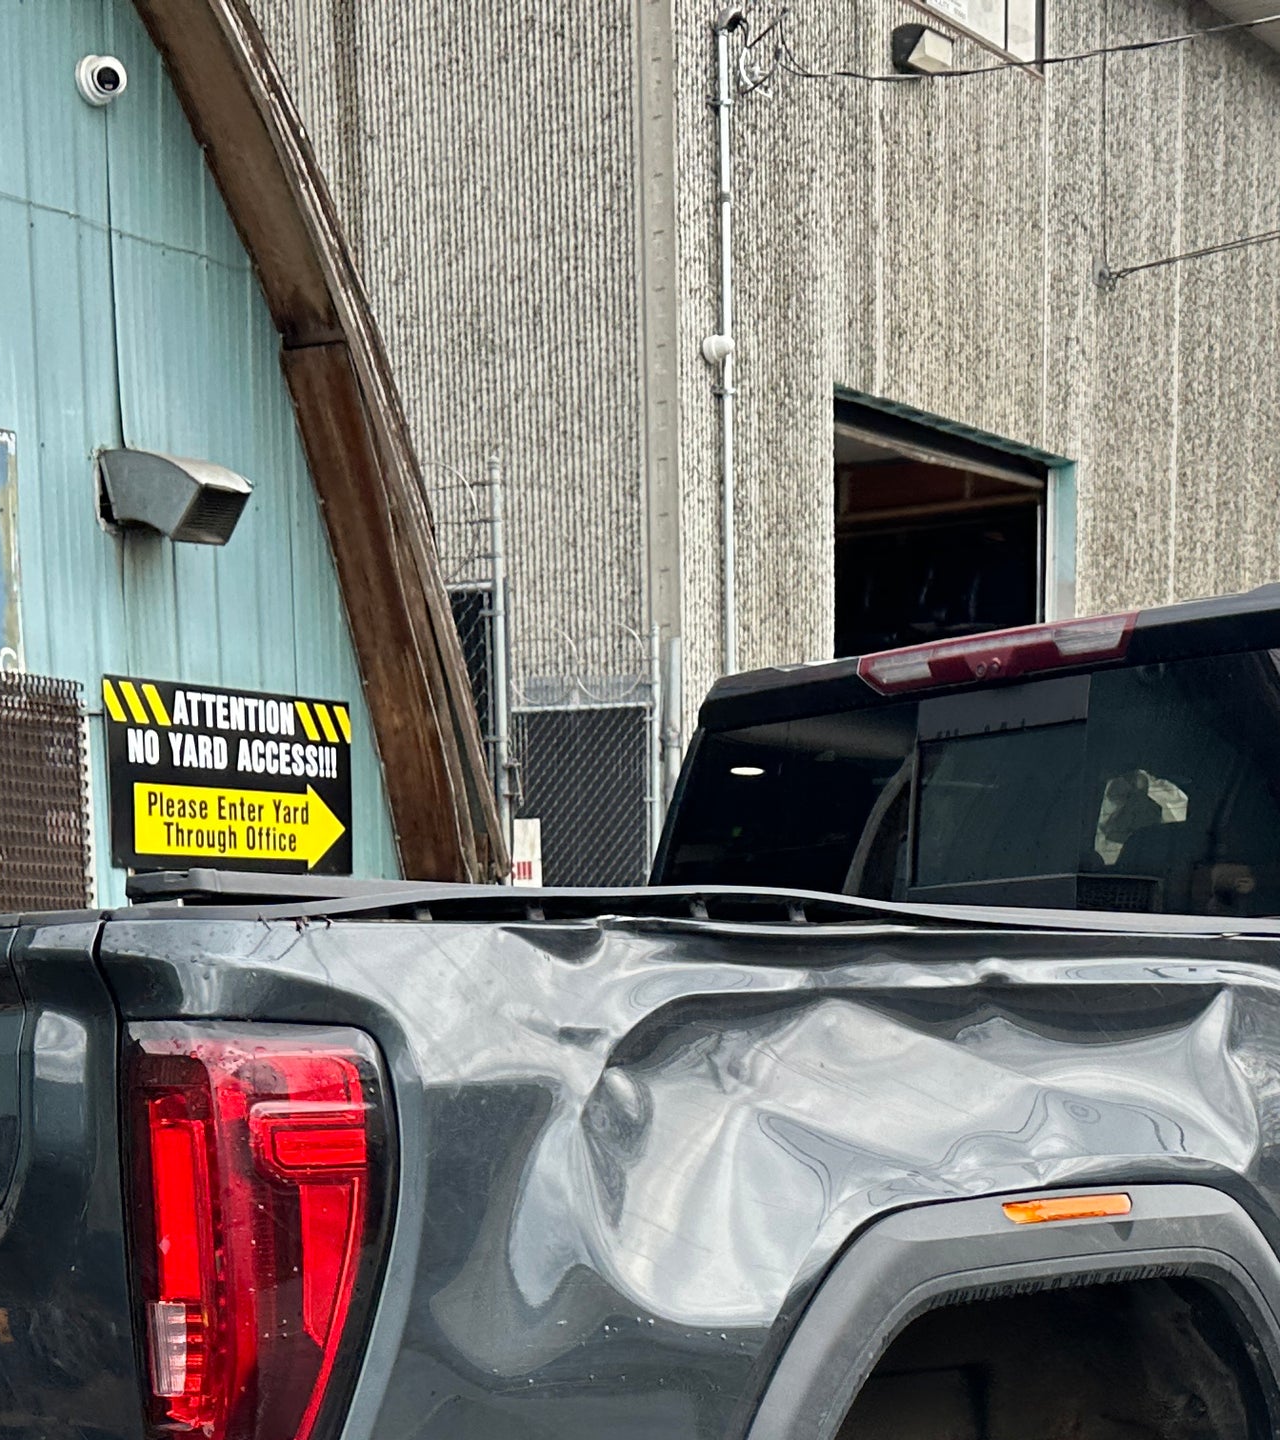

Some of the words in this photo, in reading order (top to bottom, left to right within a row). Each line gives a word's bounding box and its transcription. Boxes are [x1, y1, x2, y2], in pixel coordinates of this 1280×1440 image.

[172, 690, 296, 737] ATTENTION
[127, 728, 160, 765] NO
[168, 732, 228, 770] YARD
[237, 738, 338, 779] ACCESS!!!
[147, 791, 209, 820] Please
[217, 795, 265, 822] Enter
[272, 799, 310, 825] Yard
[163, 822, 237, 854] Through
[246, 825, 297, 853] Office
